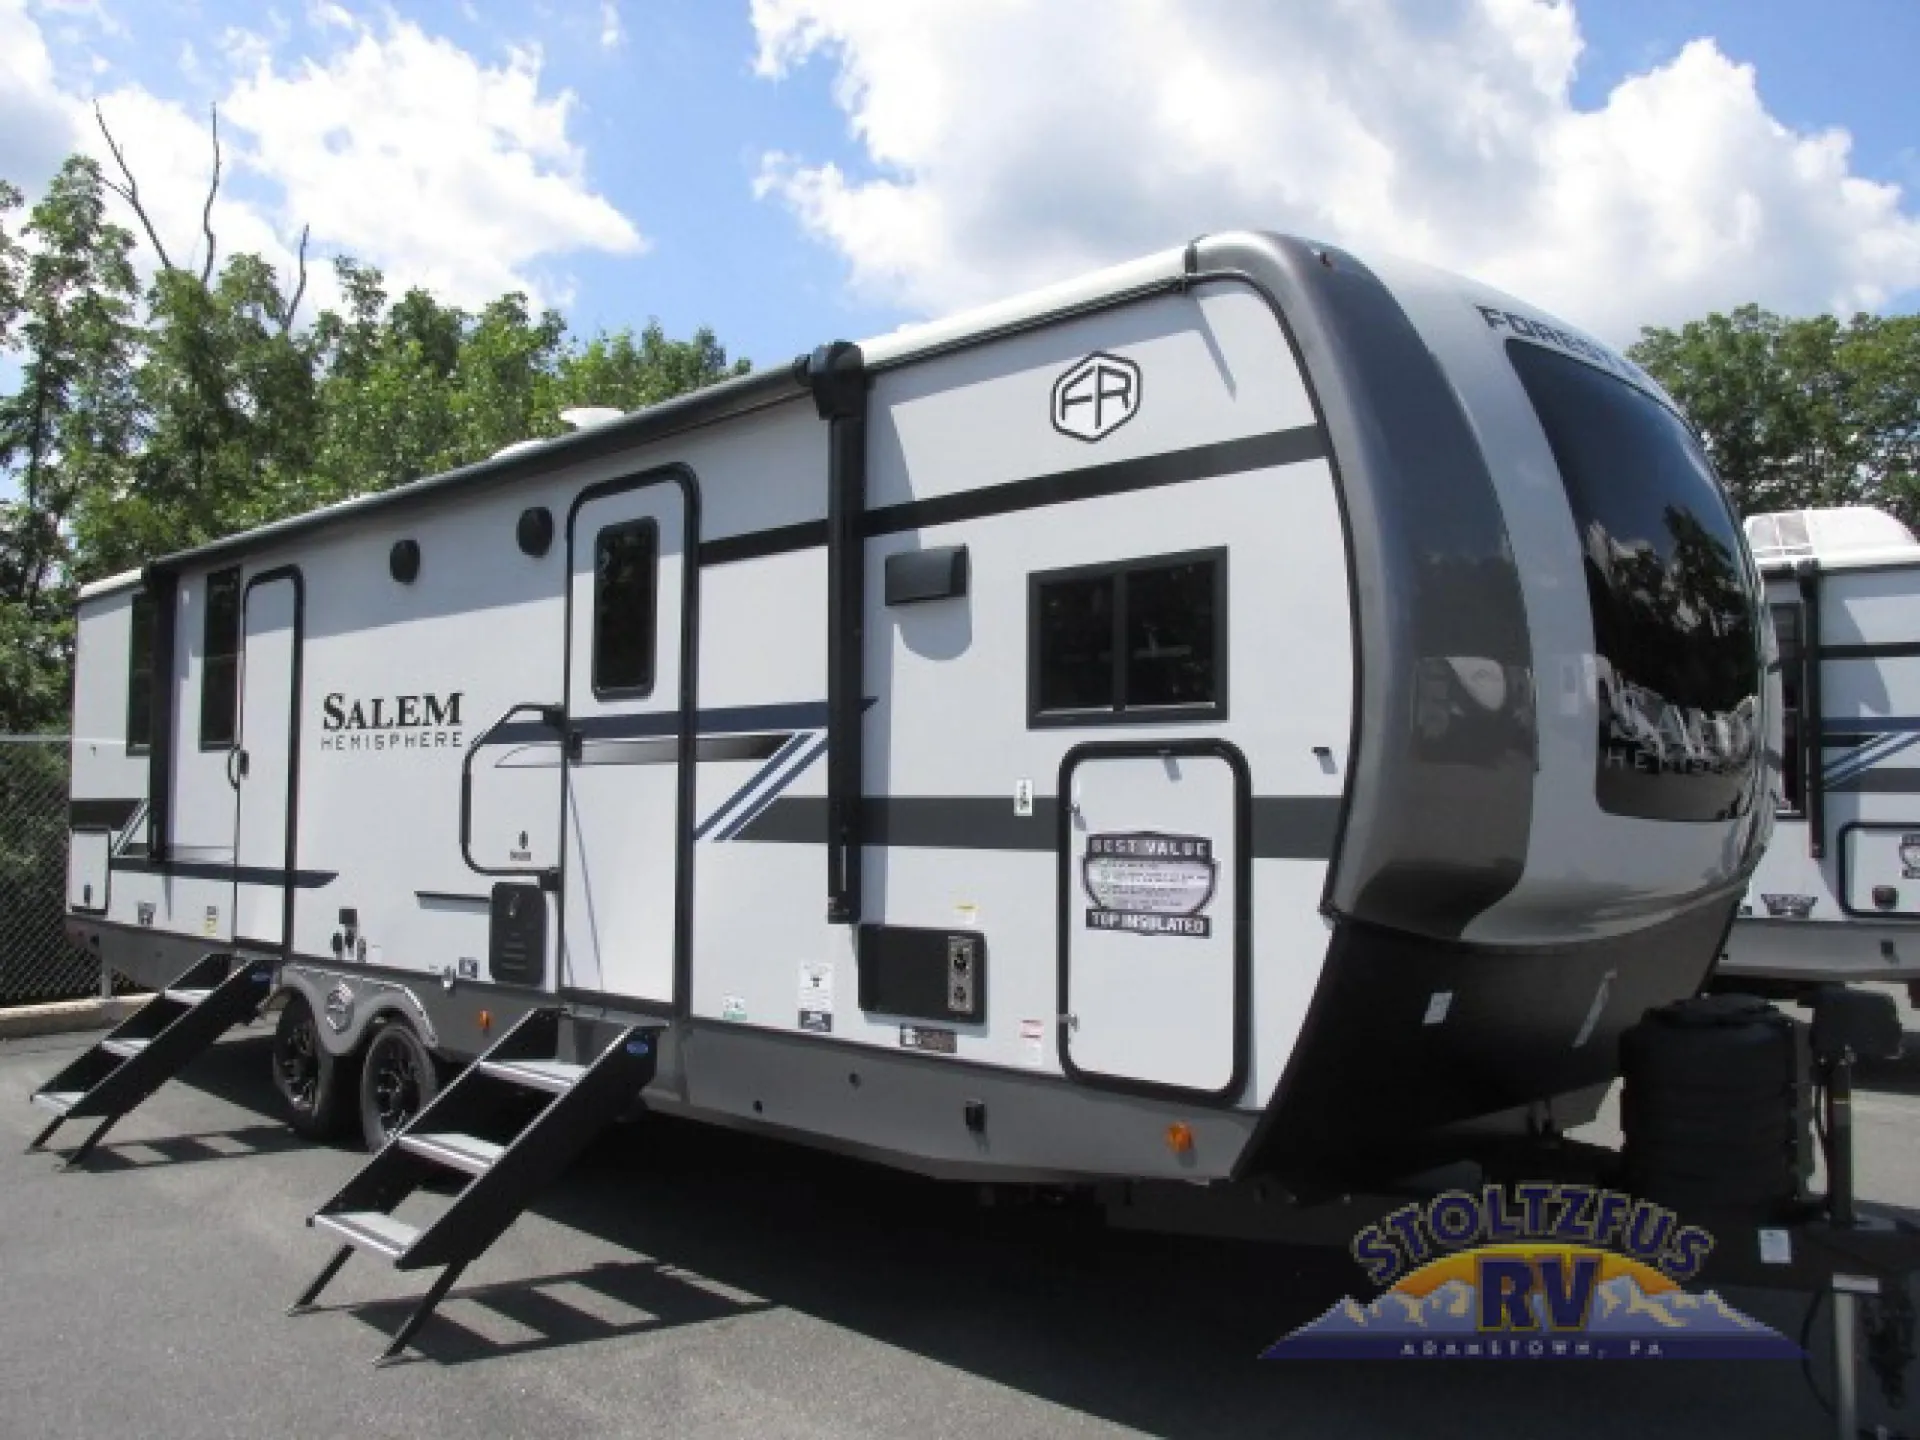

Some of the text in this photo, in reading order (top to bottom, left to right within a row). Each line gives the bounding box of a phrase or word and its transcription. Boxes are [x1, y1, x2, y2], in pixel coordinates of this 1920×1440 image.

[323, 692, 464, 732] SALEM
[321, 731, 463, 750] HEMISPHERE
[1145, 839, 1207, 856] VALUE
